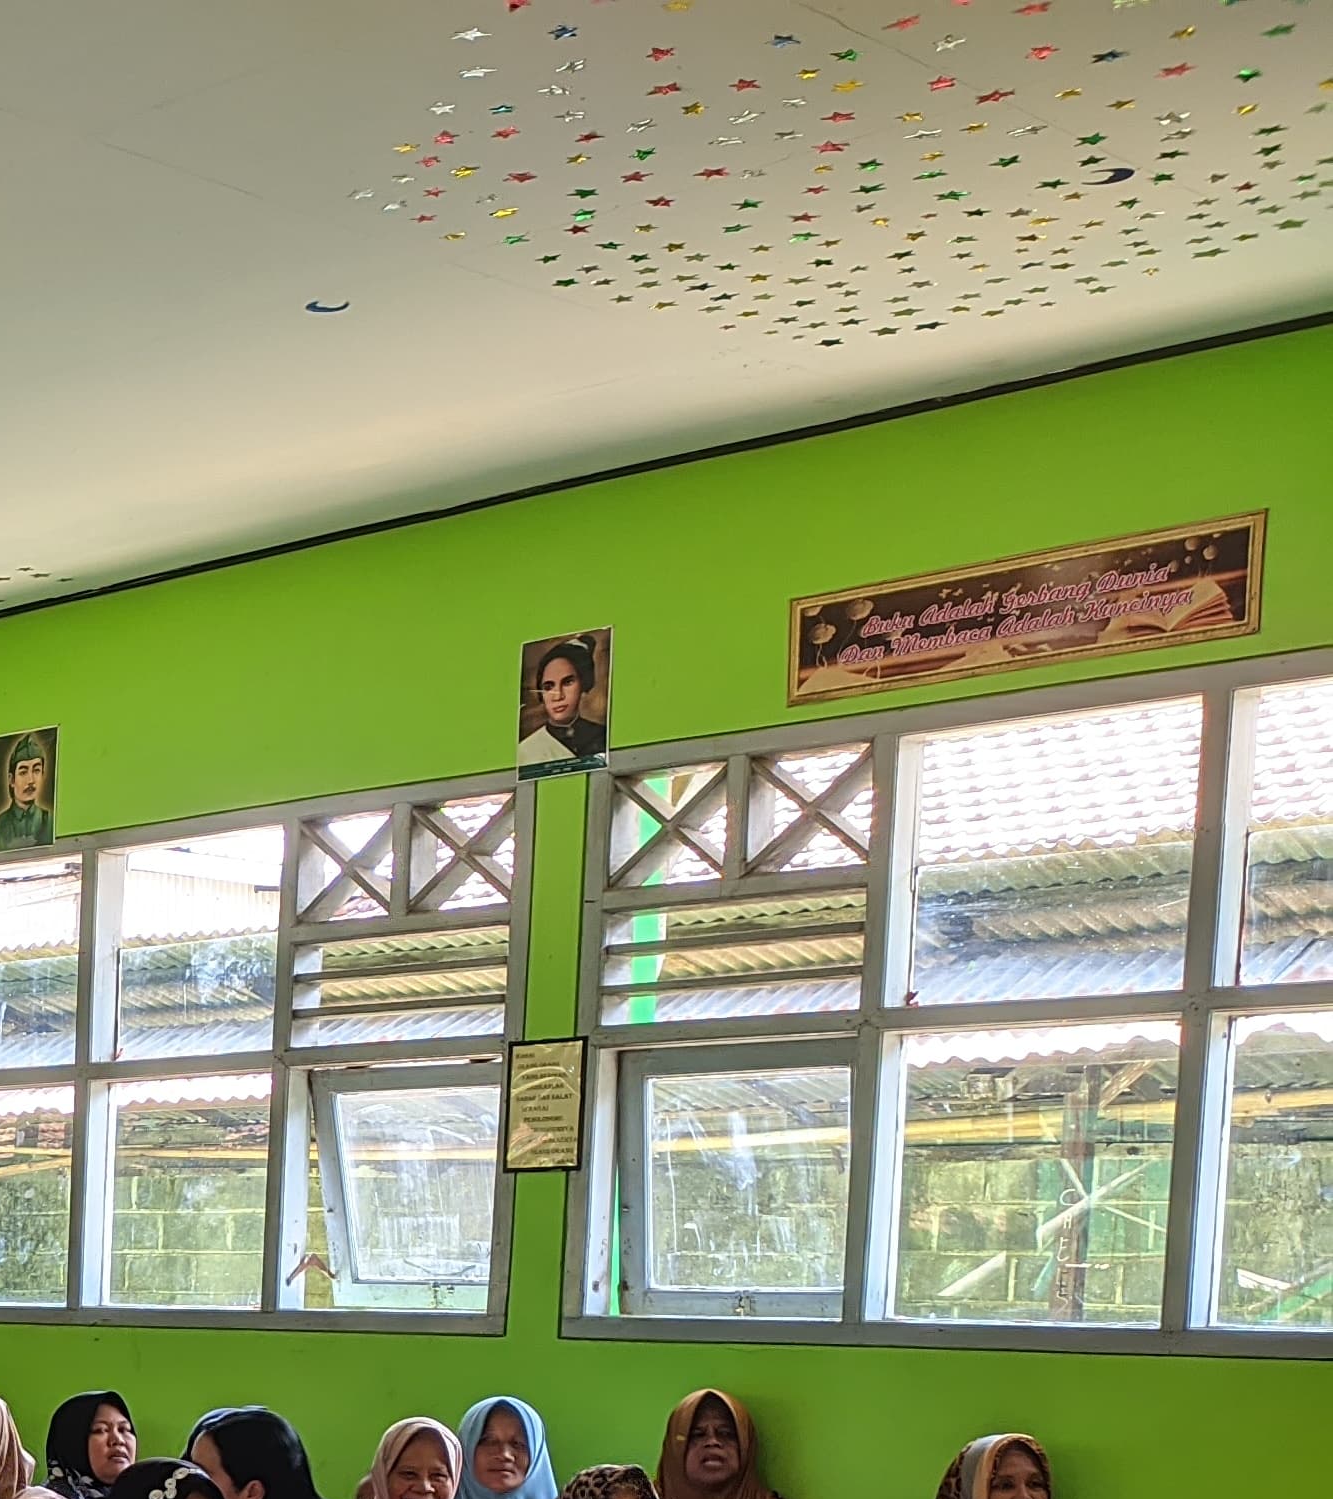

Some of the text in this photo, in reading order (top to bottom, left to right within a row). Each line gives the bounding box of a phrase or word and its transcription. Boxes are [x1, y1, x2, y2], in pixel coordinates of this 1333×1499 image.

[838, 589, 1193, 664] Dan Membaca Adalah Kuncinya
[860, 562, 1171, 638] Buku Adalah Gerbang Dunia
